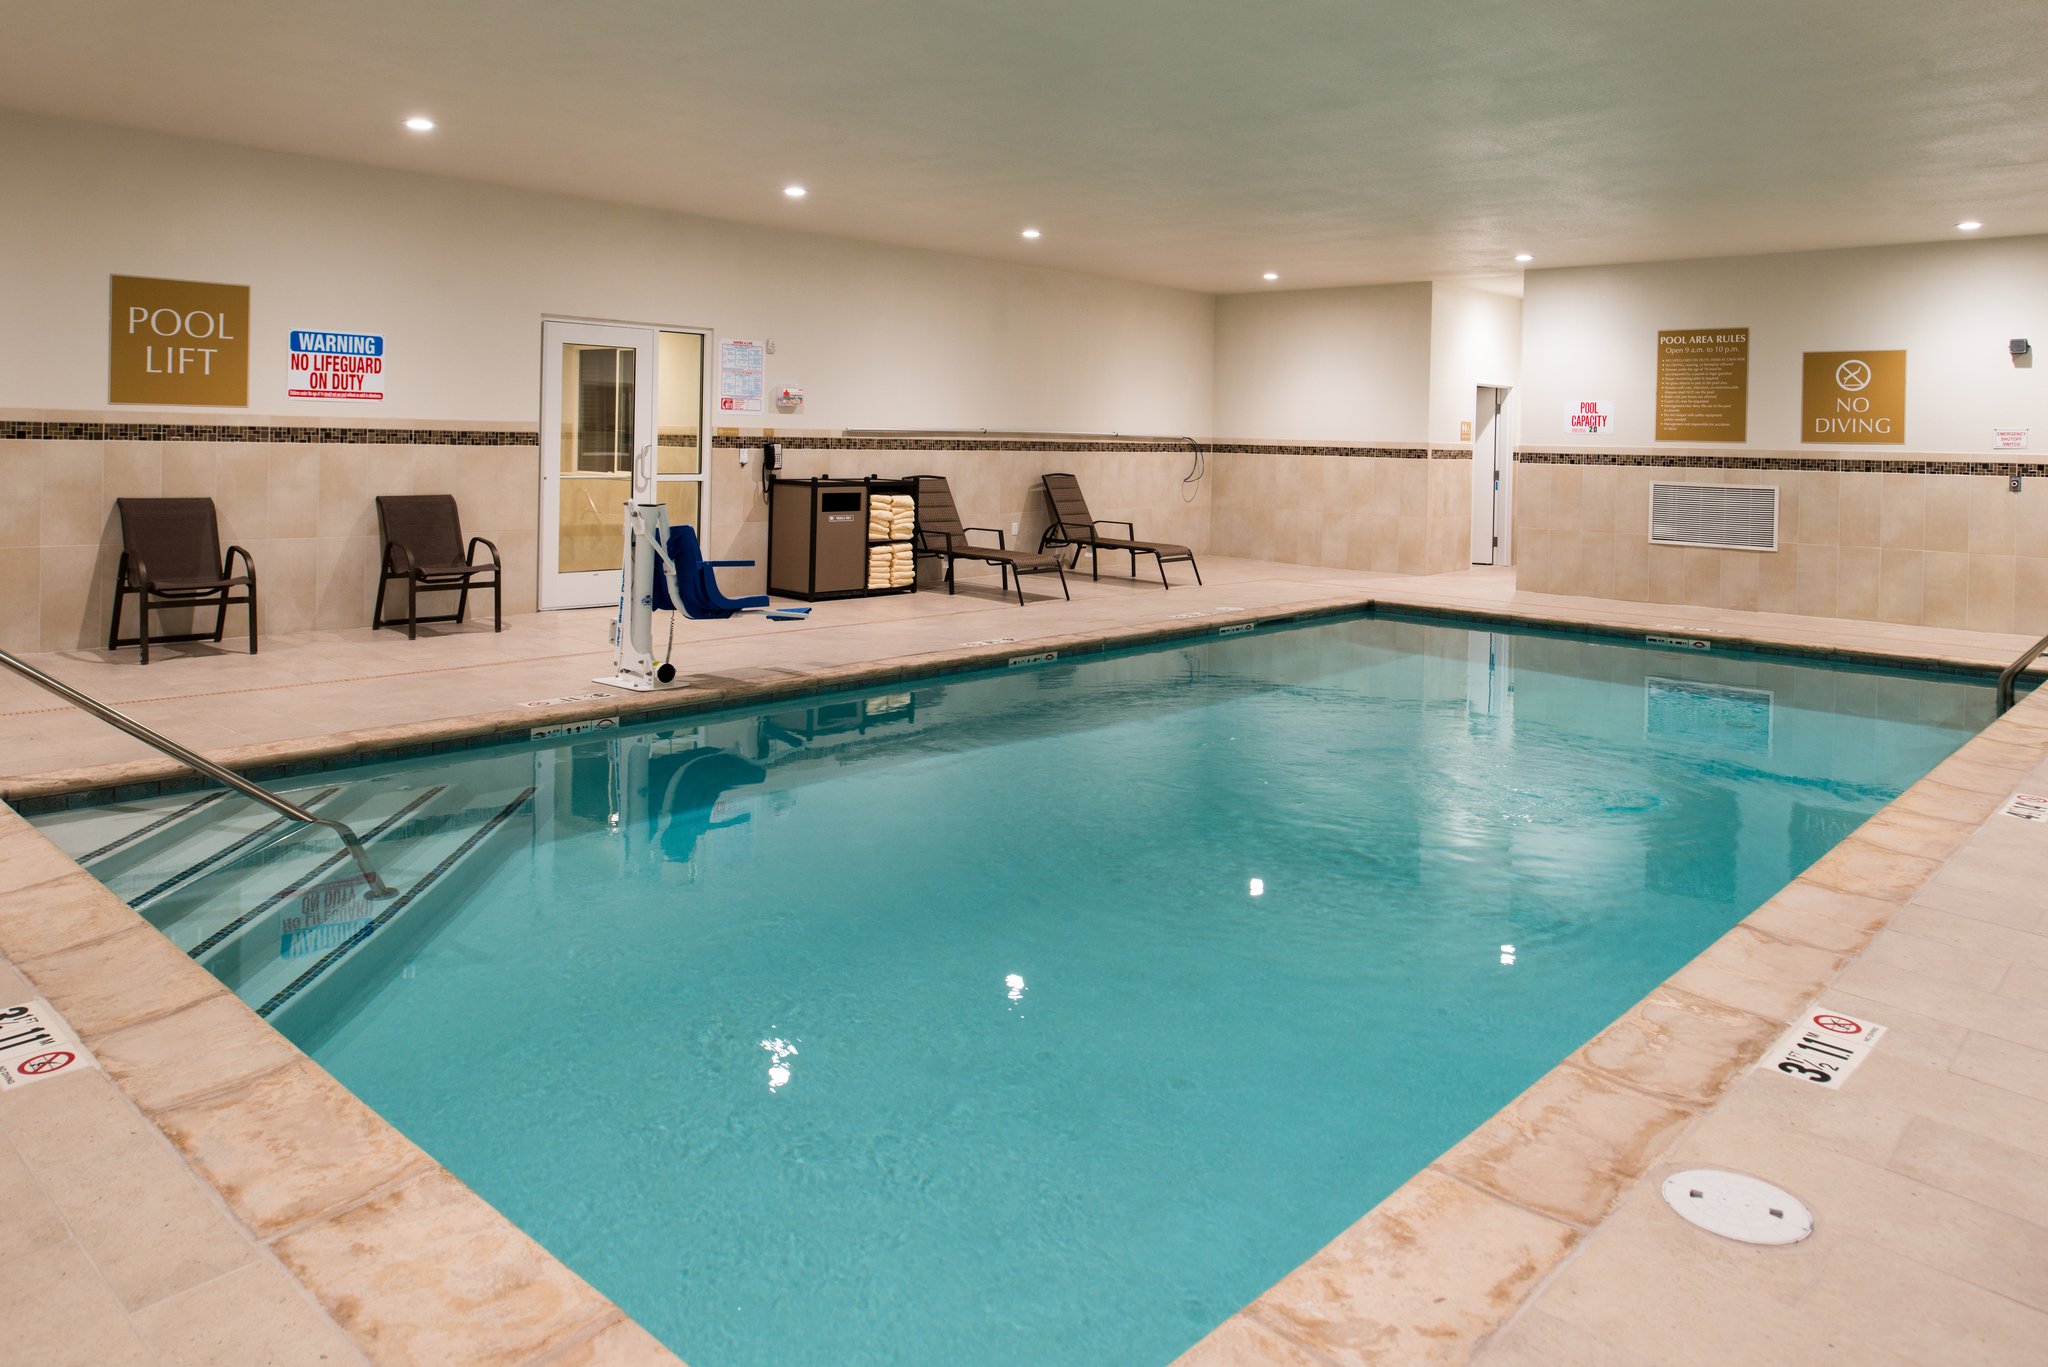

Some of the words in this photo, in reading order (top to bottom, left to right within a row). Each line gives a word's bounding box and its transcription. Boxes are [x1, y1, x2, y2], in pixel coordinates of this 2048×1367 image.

[128, 306, 234, 340] POOL
[298, 332, 376, 355] WARNING
[1660, 336, 1687, 345] POOL
[1688, 335, 1714, 344] AREA
[1716, 334, 1746, 343] RULES
[1665, 347, 1684, 355] Open
[1724, 346, 1740, 354] p.m.
[146, 345, 218, 375] LIFT
[290, 353, 309, 371] NO
[313, 354, 382, 374] LIFEGUARD
[309, 372, 328, 389] ON
[332, 373, 364, 391] DUTY
[1580, 401, 1599, 414] POOL
[1836, 396, 1870, 413] NO
[1571, 414, 1608, 427] CAPACITY
[1815, 417, 1891, 434] DIVING
[1778, 1061, 1832, 1083] 3
